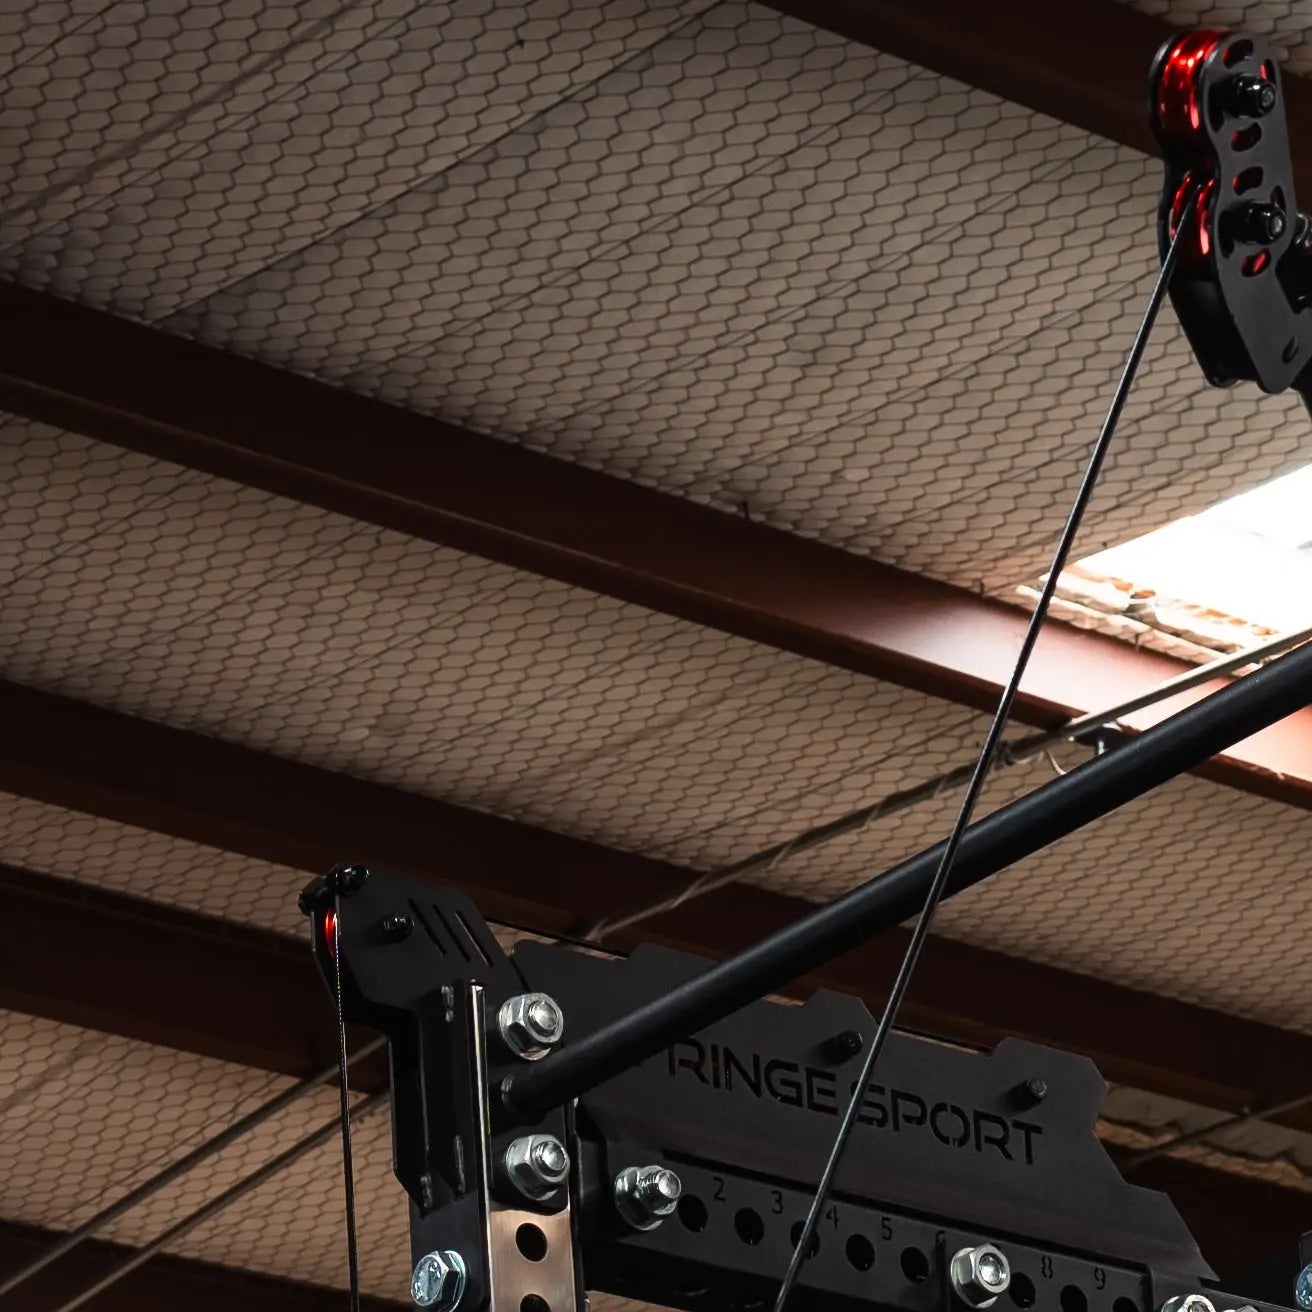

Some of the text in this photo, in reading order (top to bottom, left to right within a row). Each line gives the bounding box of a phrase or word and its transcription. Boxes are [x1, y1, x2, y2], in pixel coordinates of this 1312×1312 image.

[666, 1037, 1044, 1166] RINGE SPORT
[713, 1177, 727, 1201] 2
[771, 1191, 784, 1215] 3
[826, 1205, 839, 1230] 4
[881, 1217, 893, 1242] 5
[1041, 1256, 1053, 1279] 8
[1093, 1267, 1106, 1291] 9
